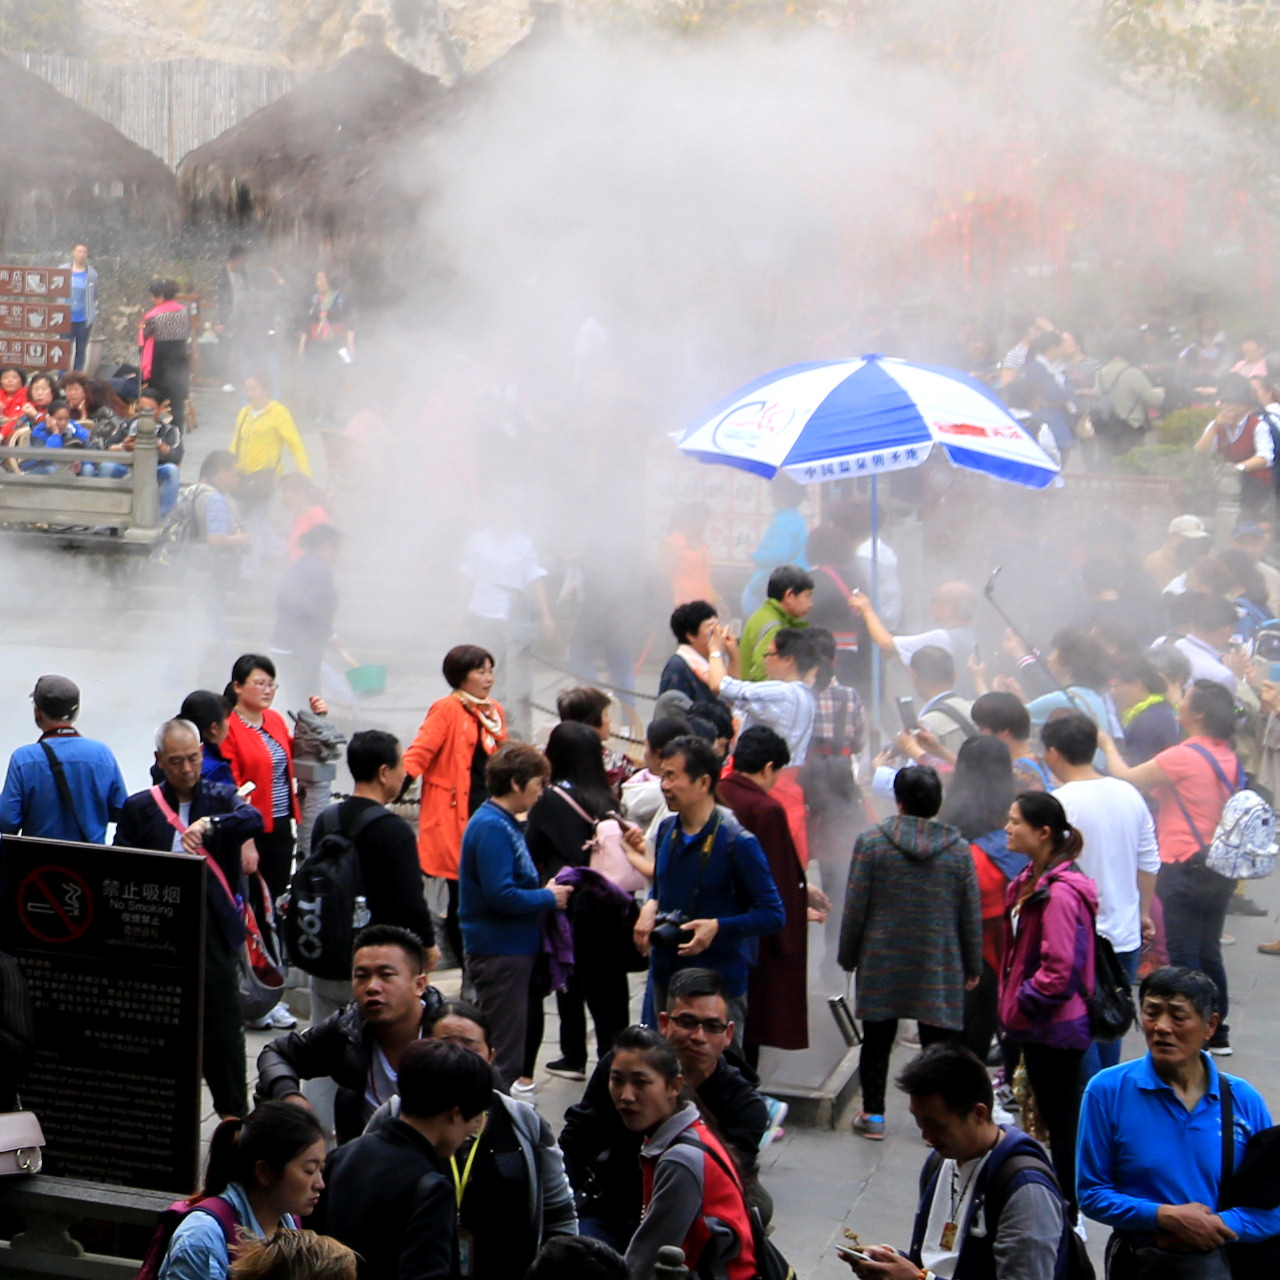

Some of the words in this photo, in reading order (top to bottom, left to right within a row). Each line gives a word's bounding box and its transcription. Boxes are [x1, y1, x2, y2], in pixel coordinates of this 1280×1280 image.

[101, 878, 181, 904] 禁止吸烟
[109, 899, 125, 910] No
[127, 900, 174, 918] Smoking
